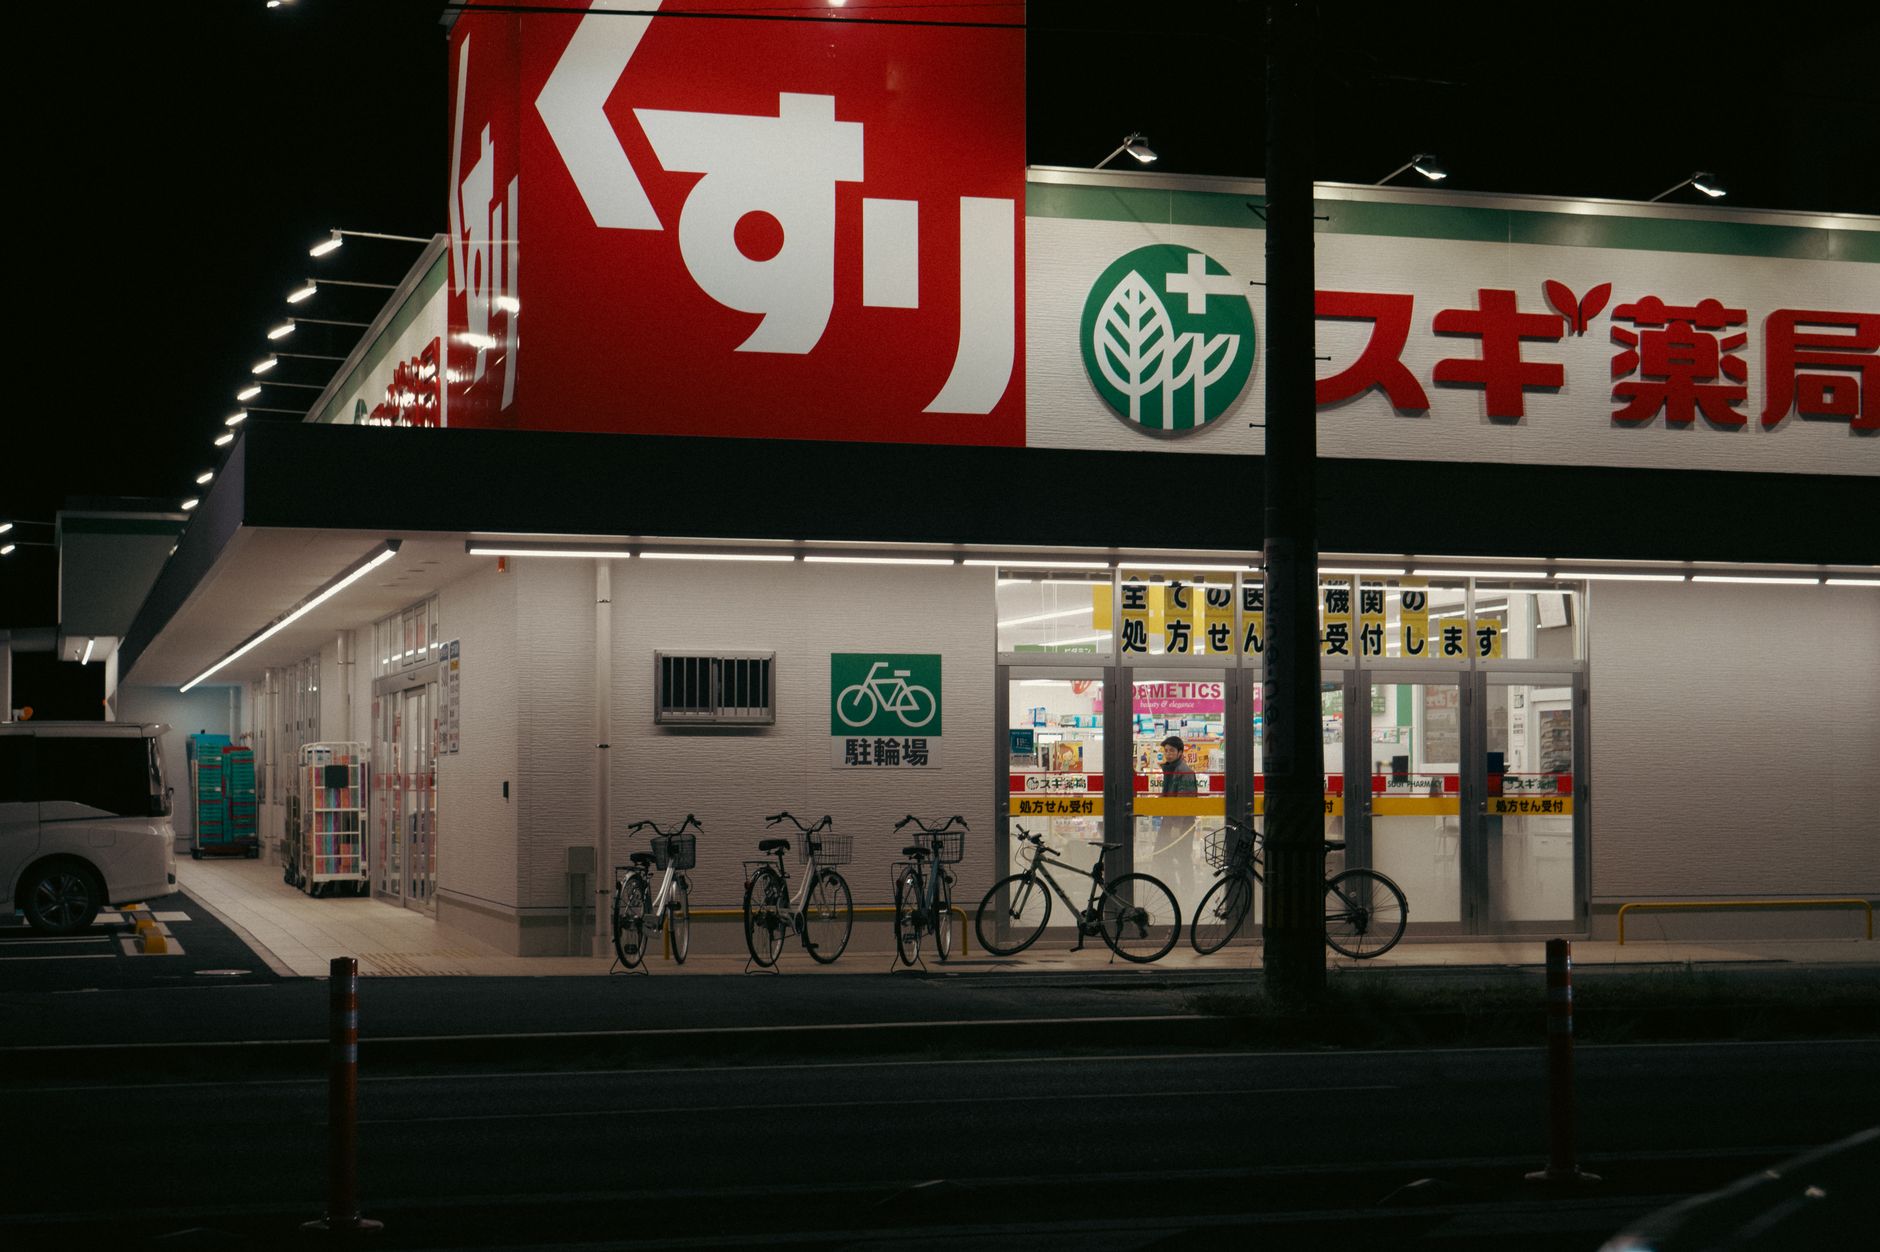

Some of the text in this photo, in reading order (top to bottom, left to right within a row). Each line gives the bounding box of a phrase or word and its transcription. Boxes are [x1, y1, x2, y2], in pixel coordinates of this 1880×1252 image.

[534, 0, 1015, 415] くすり
[1315, 279, 1880, 430] スギ薬局
[844, 738, 929, 767] 駐輪場
[1020, 800, 1093, 814] 処方せん受付
[1496, 800, 1563, 813] 処方せん受付
